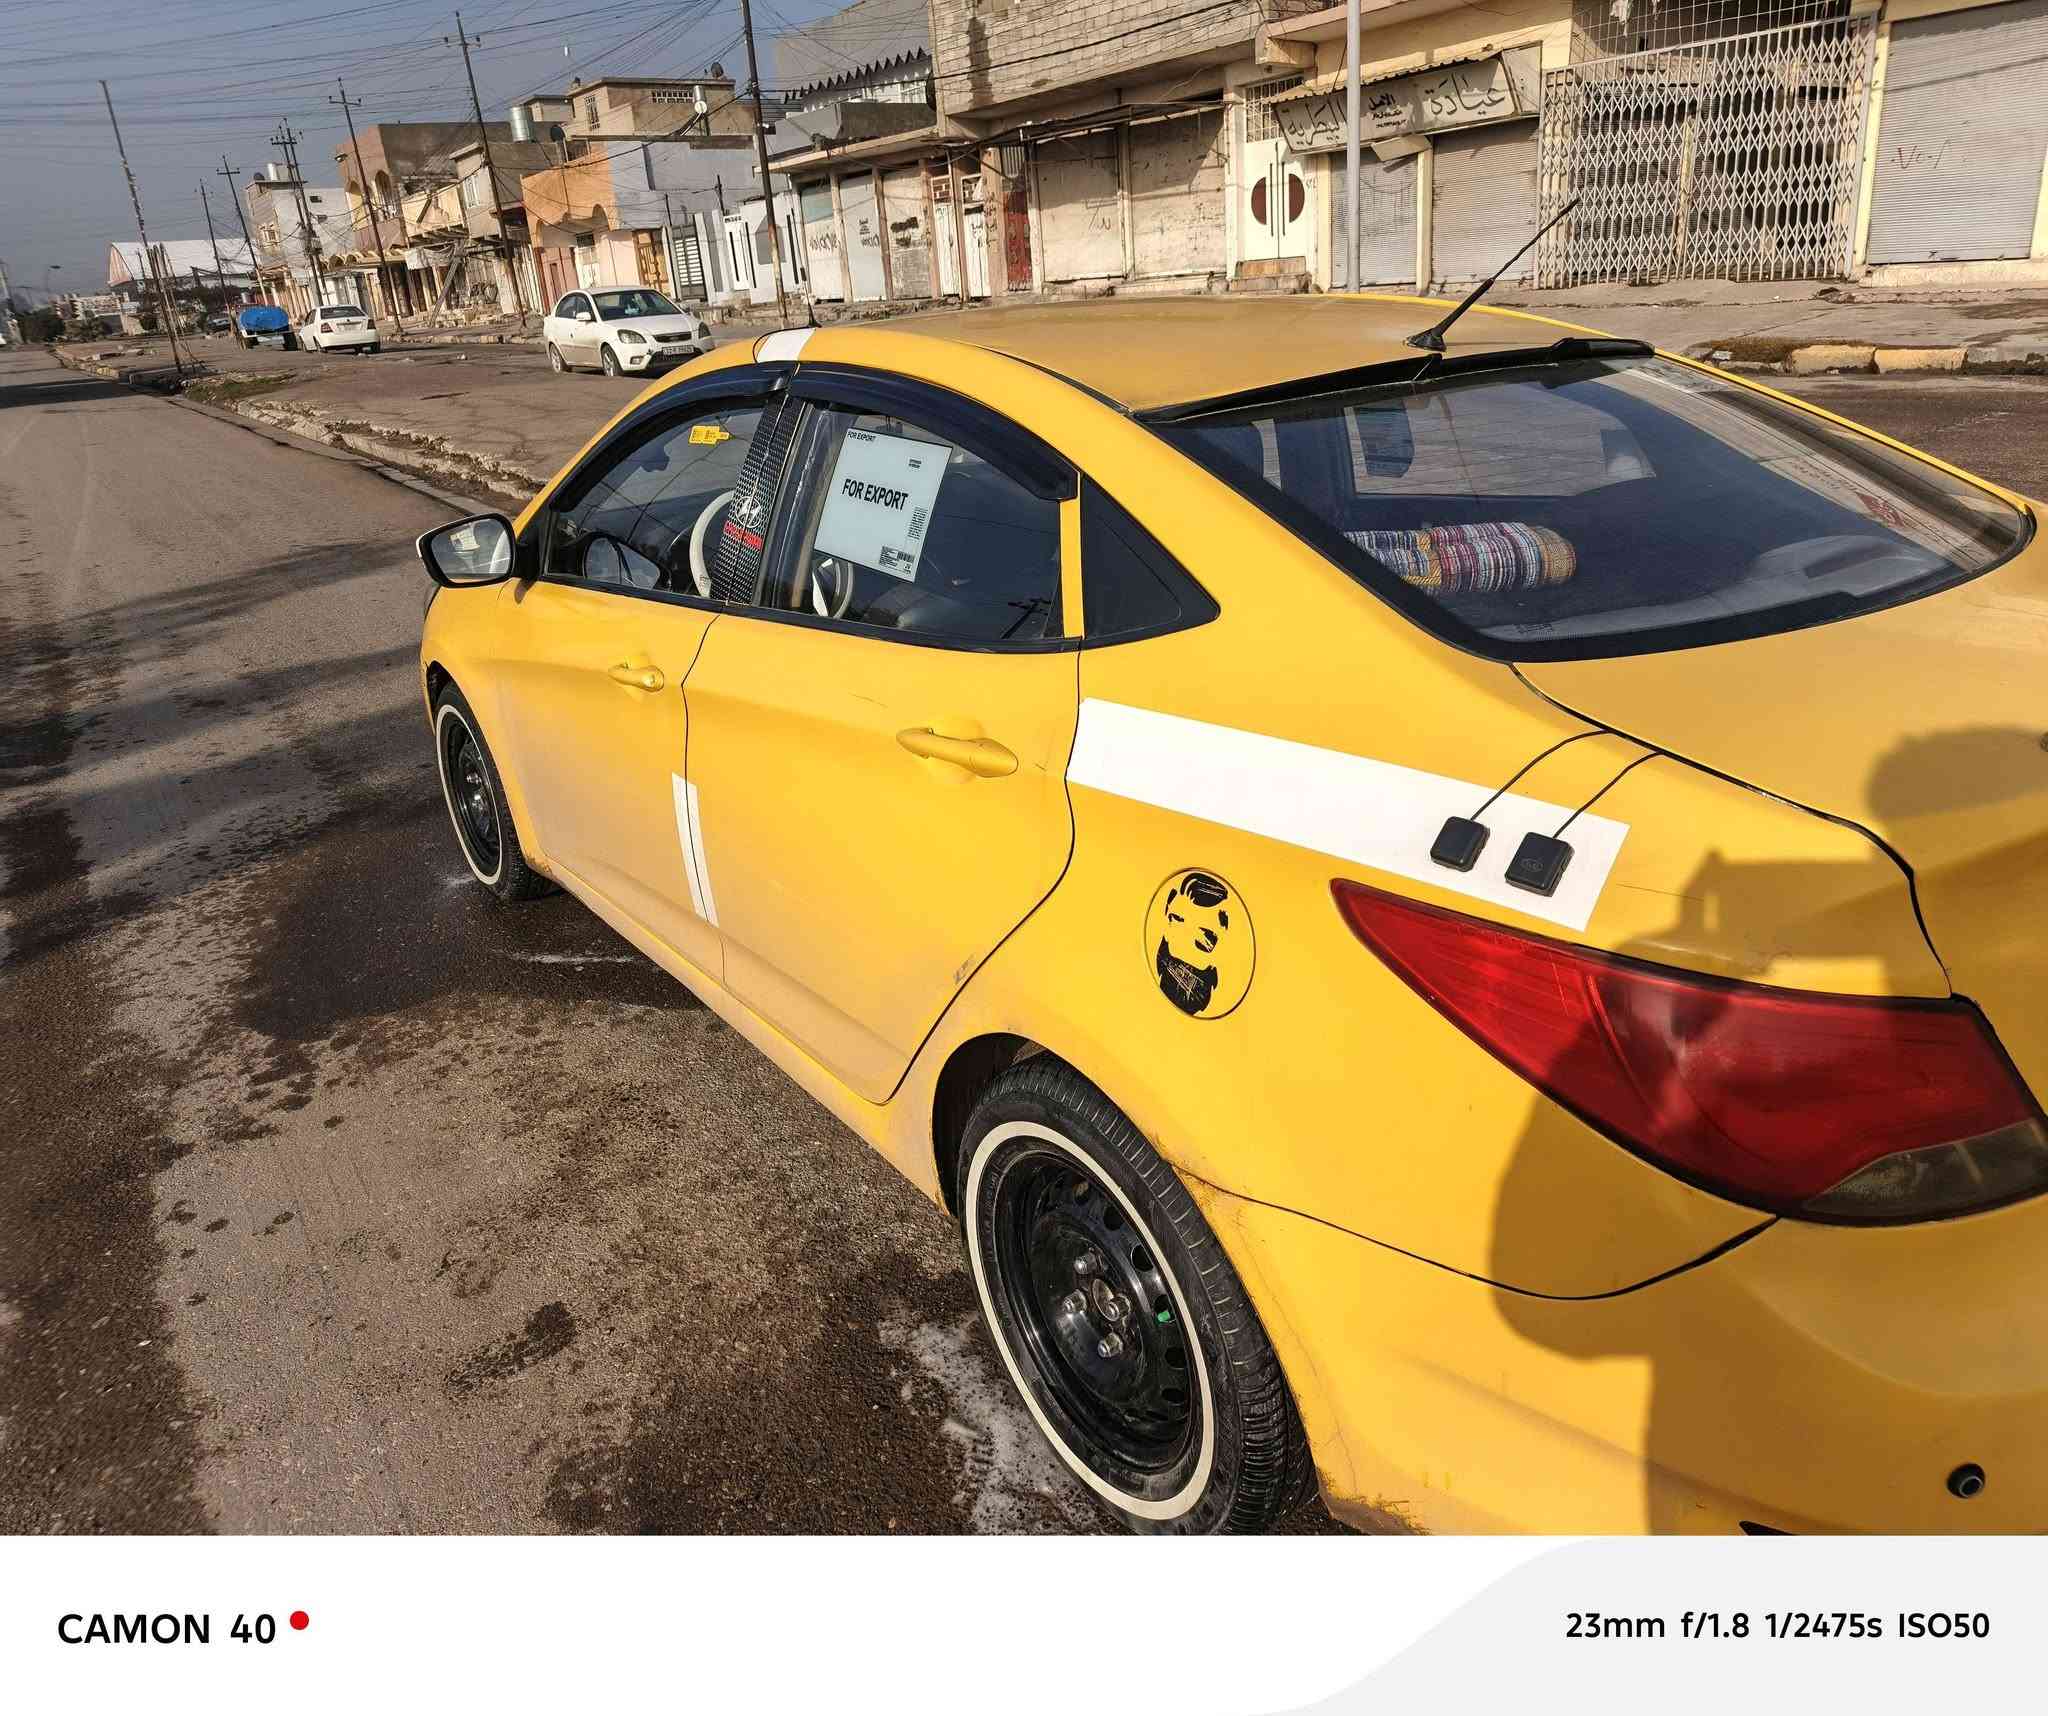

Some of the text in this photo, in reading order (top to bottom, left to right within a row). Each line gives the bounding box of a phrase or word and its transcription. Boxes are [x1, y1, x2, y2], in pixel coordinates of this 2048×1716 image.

[1425, 72, 1507, 115] عيادة
[1281, 97, 1347, 146] البيطرية
[847, 431, 877, 442] FOR EXPORT
[842, 478, 909, 511] FOR EXPORT
